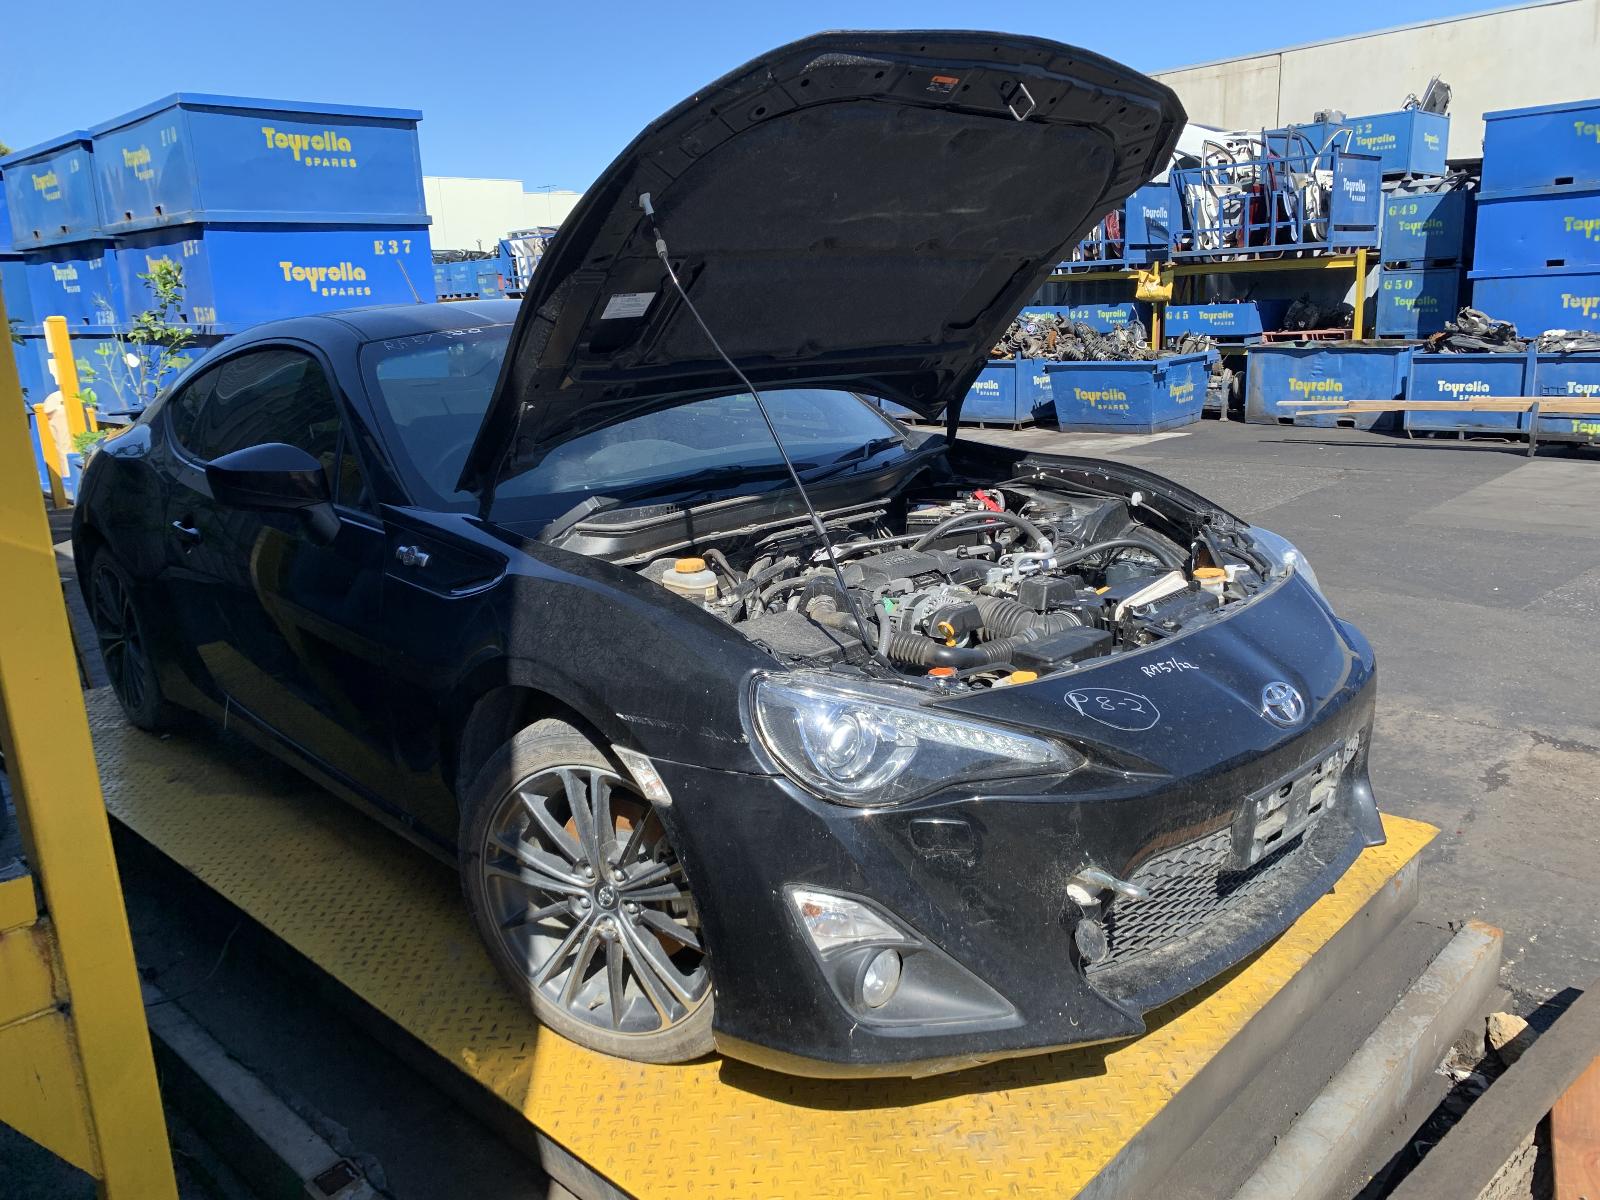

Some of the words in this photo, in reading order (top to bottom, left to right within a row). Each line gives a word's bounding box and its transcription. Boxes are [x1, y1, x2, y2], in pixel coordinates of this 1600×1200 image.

[262, 127, 351, 161] Toyrolla
[305, 157, 357, 168] SPARES
[279, 261, 366, 292] Toyrolla
[321, 287, 371, 297] SPARES
[1074, 387, 1127, 407] Toyrolla
[1289, 377, 1343, 399] Toyrolla
[1438, 380, 1490, 398] Toyrolla
